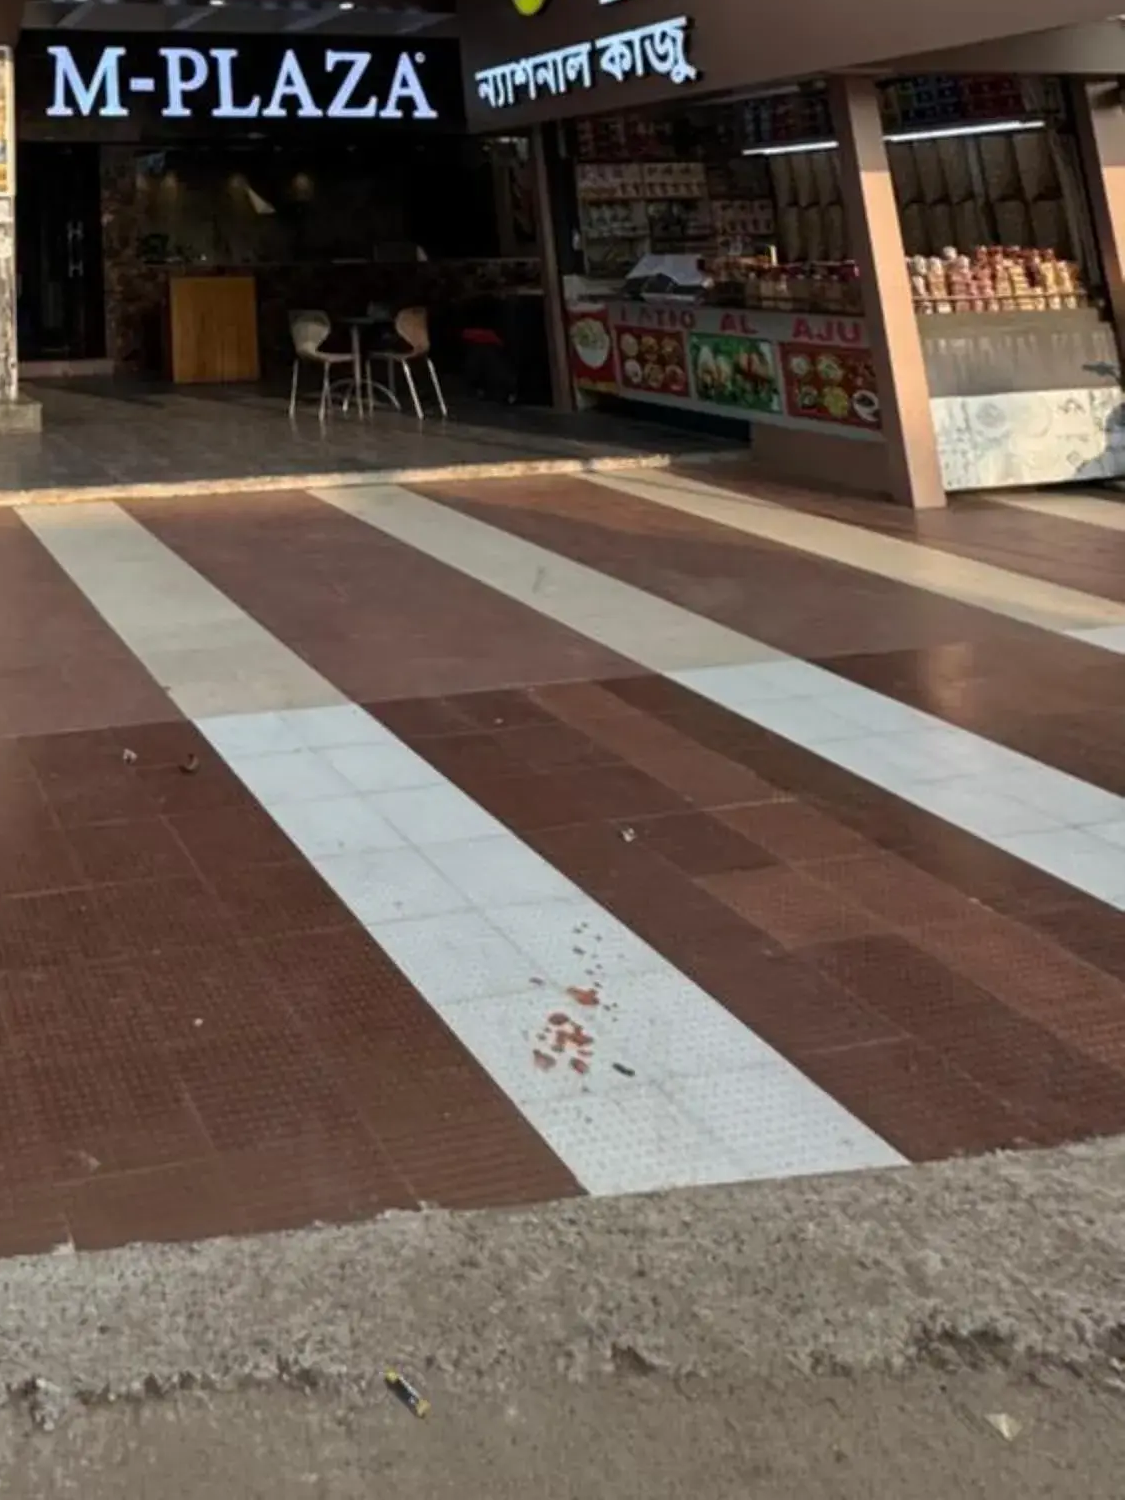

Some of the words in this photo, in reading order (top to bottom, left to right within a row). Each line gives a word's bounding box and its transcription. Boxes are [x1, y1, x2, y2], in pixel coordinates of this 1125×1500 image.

[46, 45, 439, 119] M-PLAZA
[475, 42, 592, 108] ন্যাশনাল
[595, 15, 697, 84] কাজু
